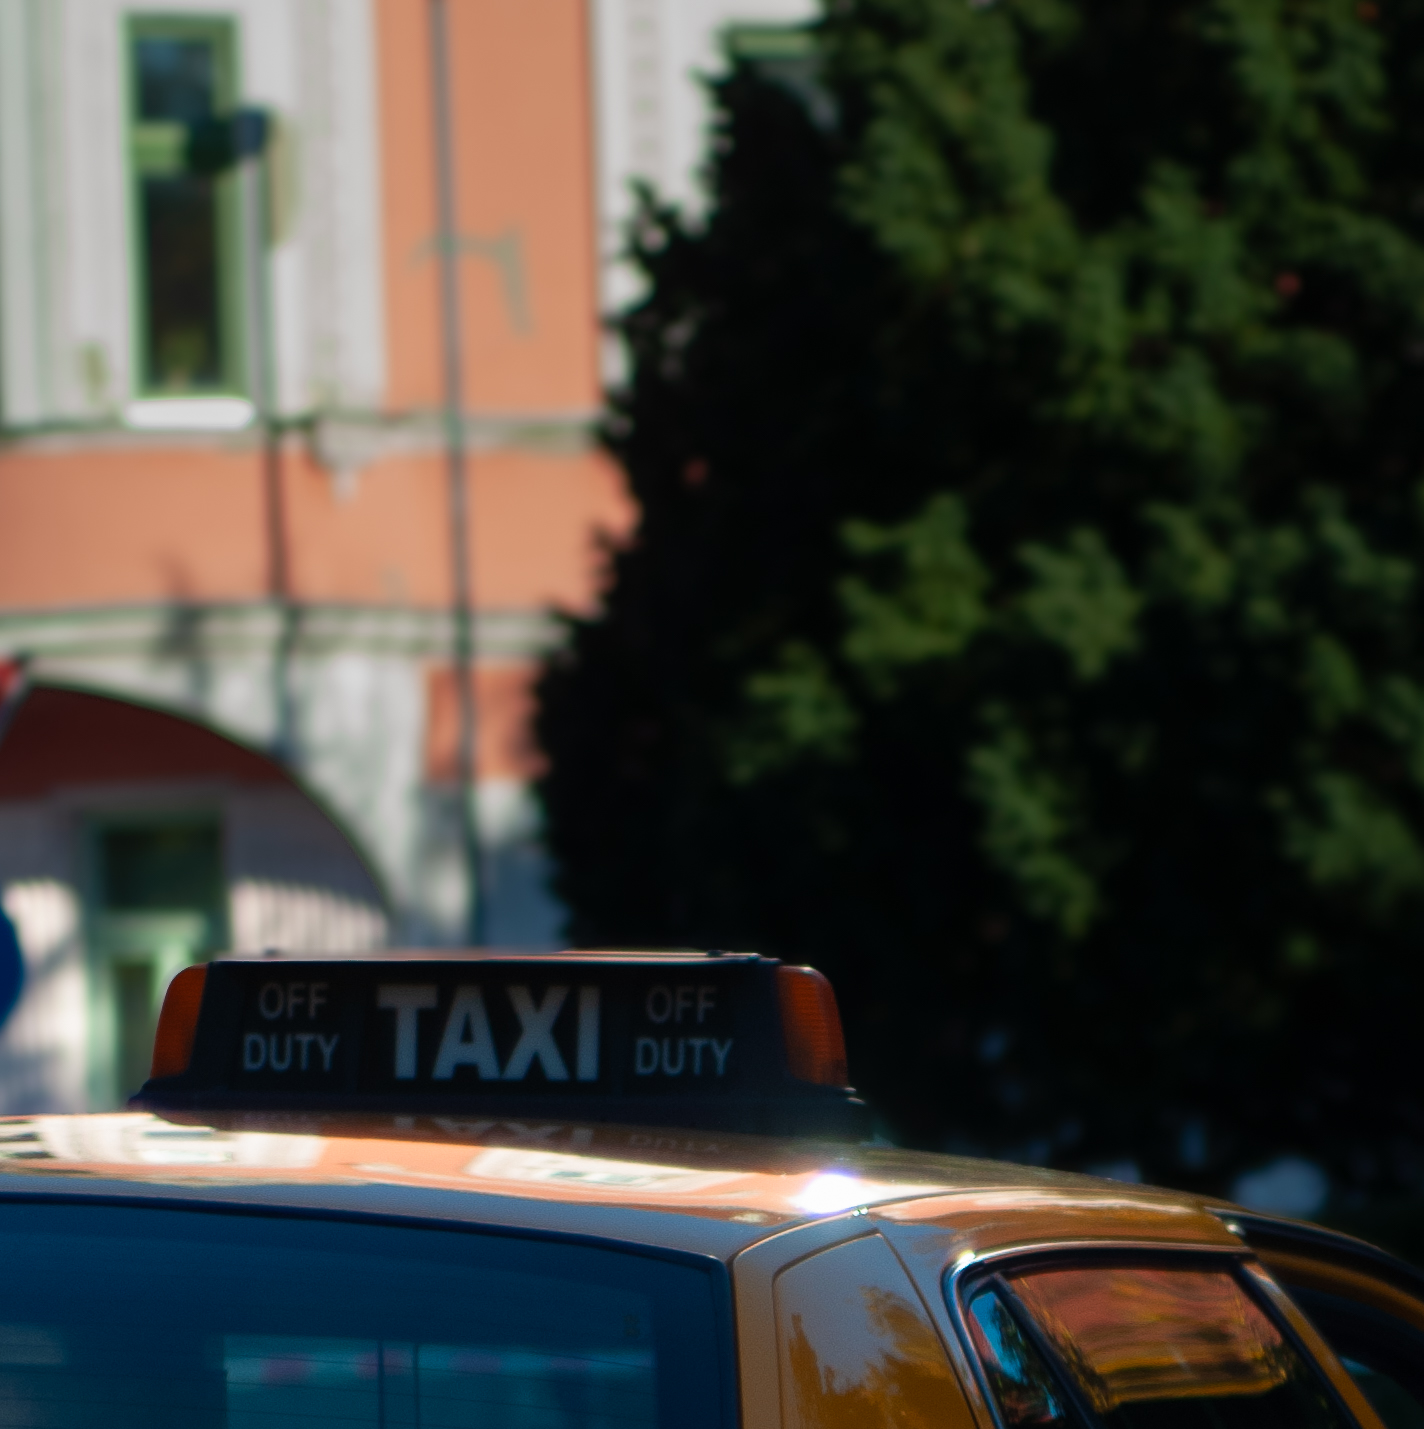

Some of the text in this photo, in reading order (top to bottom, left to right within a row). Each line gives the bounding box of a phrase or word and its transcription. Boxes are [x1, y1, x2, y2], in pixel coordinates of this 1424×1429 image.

[257, 981, 328, 1021] OFF
[644, 983, 718, 1024] OFF
[241, 1031, 340, 1072] DUTY
[376, 984, 601, 1082] TAXI
[634, 1036, 734, 1077] DUTY
